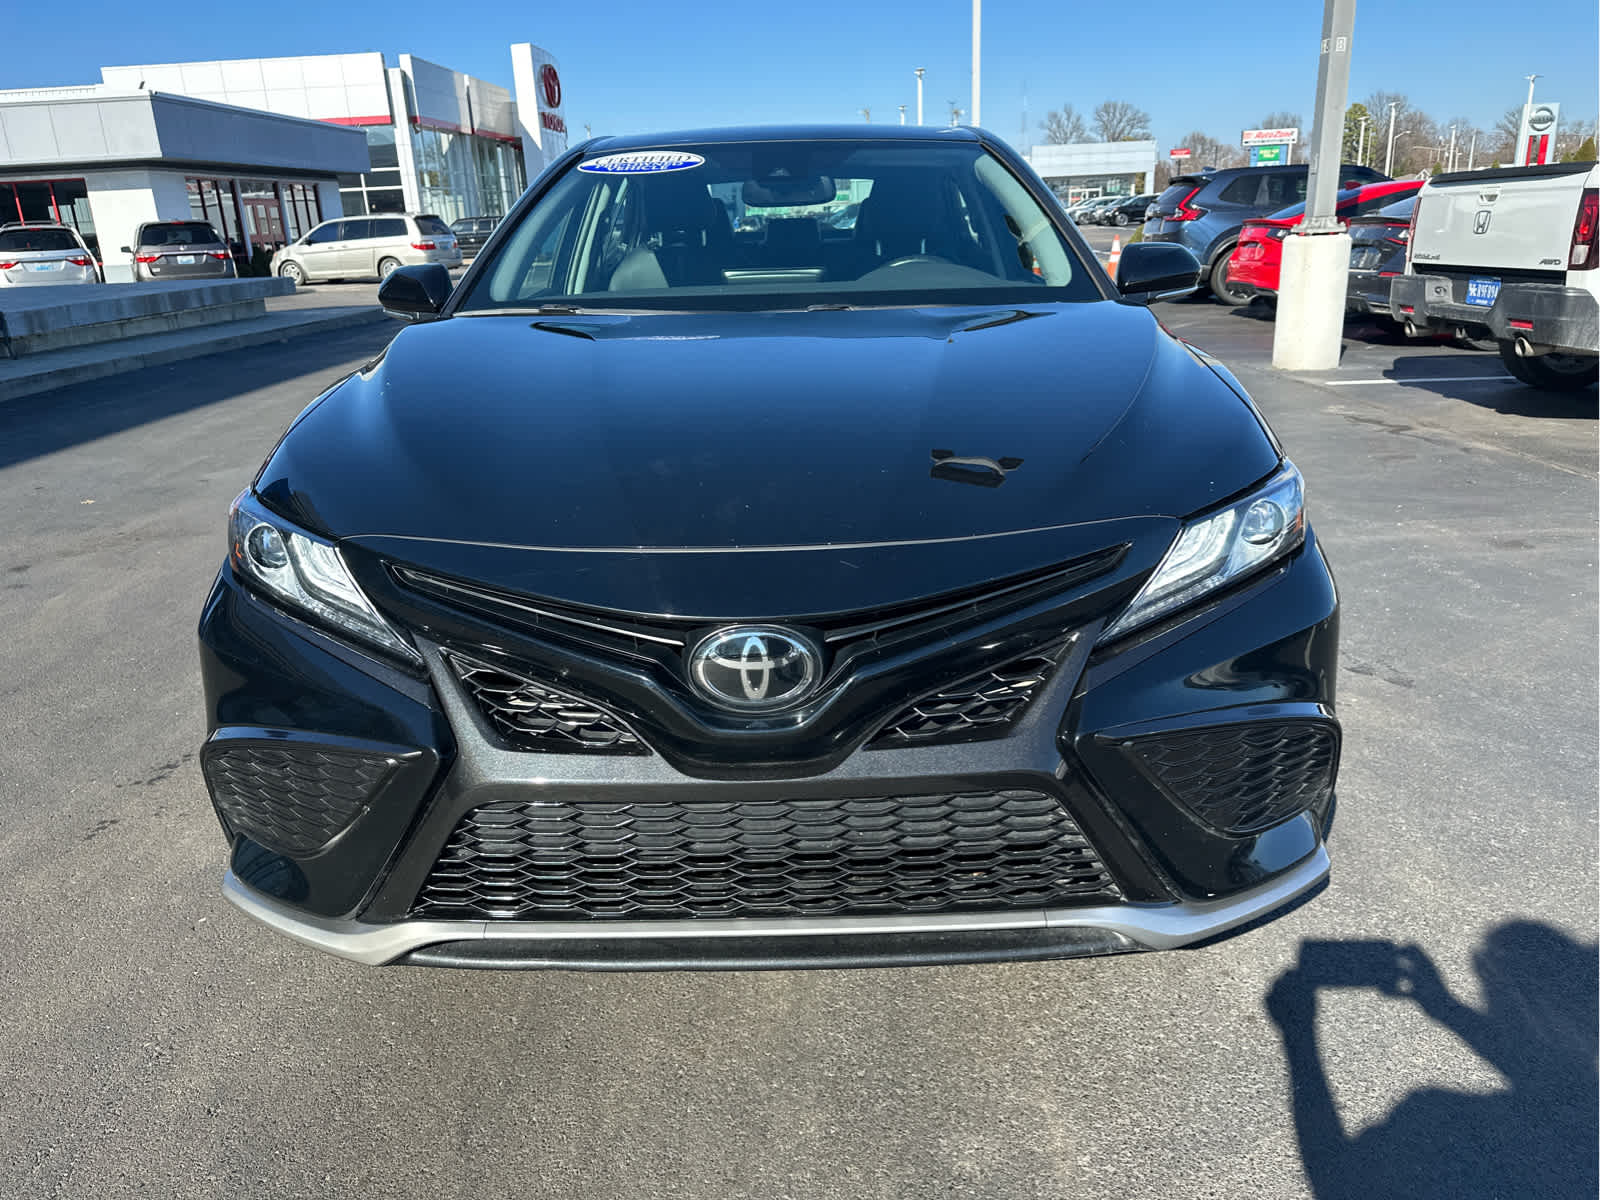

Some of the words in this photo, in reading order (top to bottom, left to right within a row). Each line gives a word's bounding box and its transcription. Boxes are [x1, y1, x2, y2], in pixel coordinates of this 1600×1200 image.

[595, 155, 692, 165] CERTIFIED
[607, 164, 669, 172] VEHICLE
[1538, 258, 1562, 266] AWD
